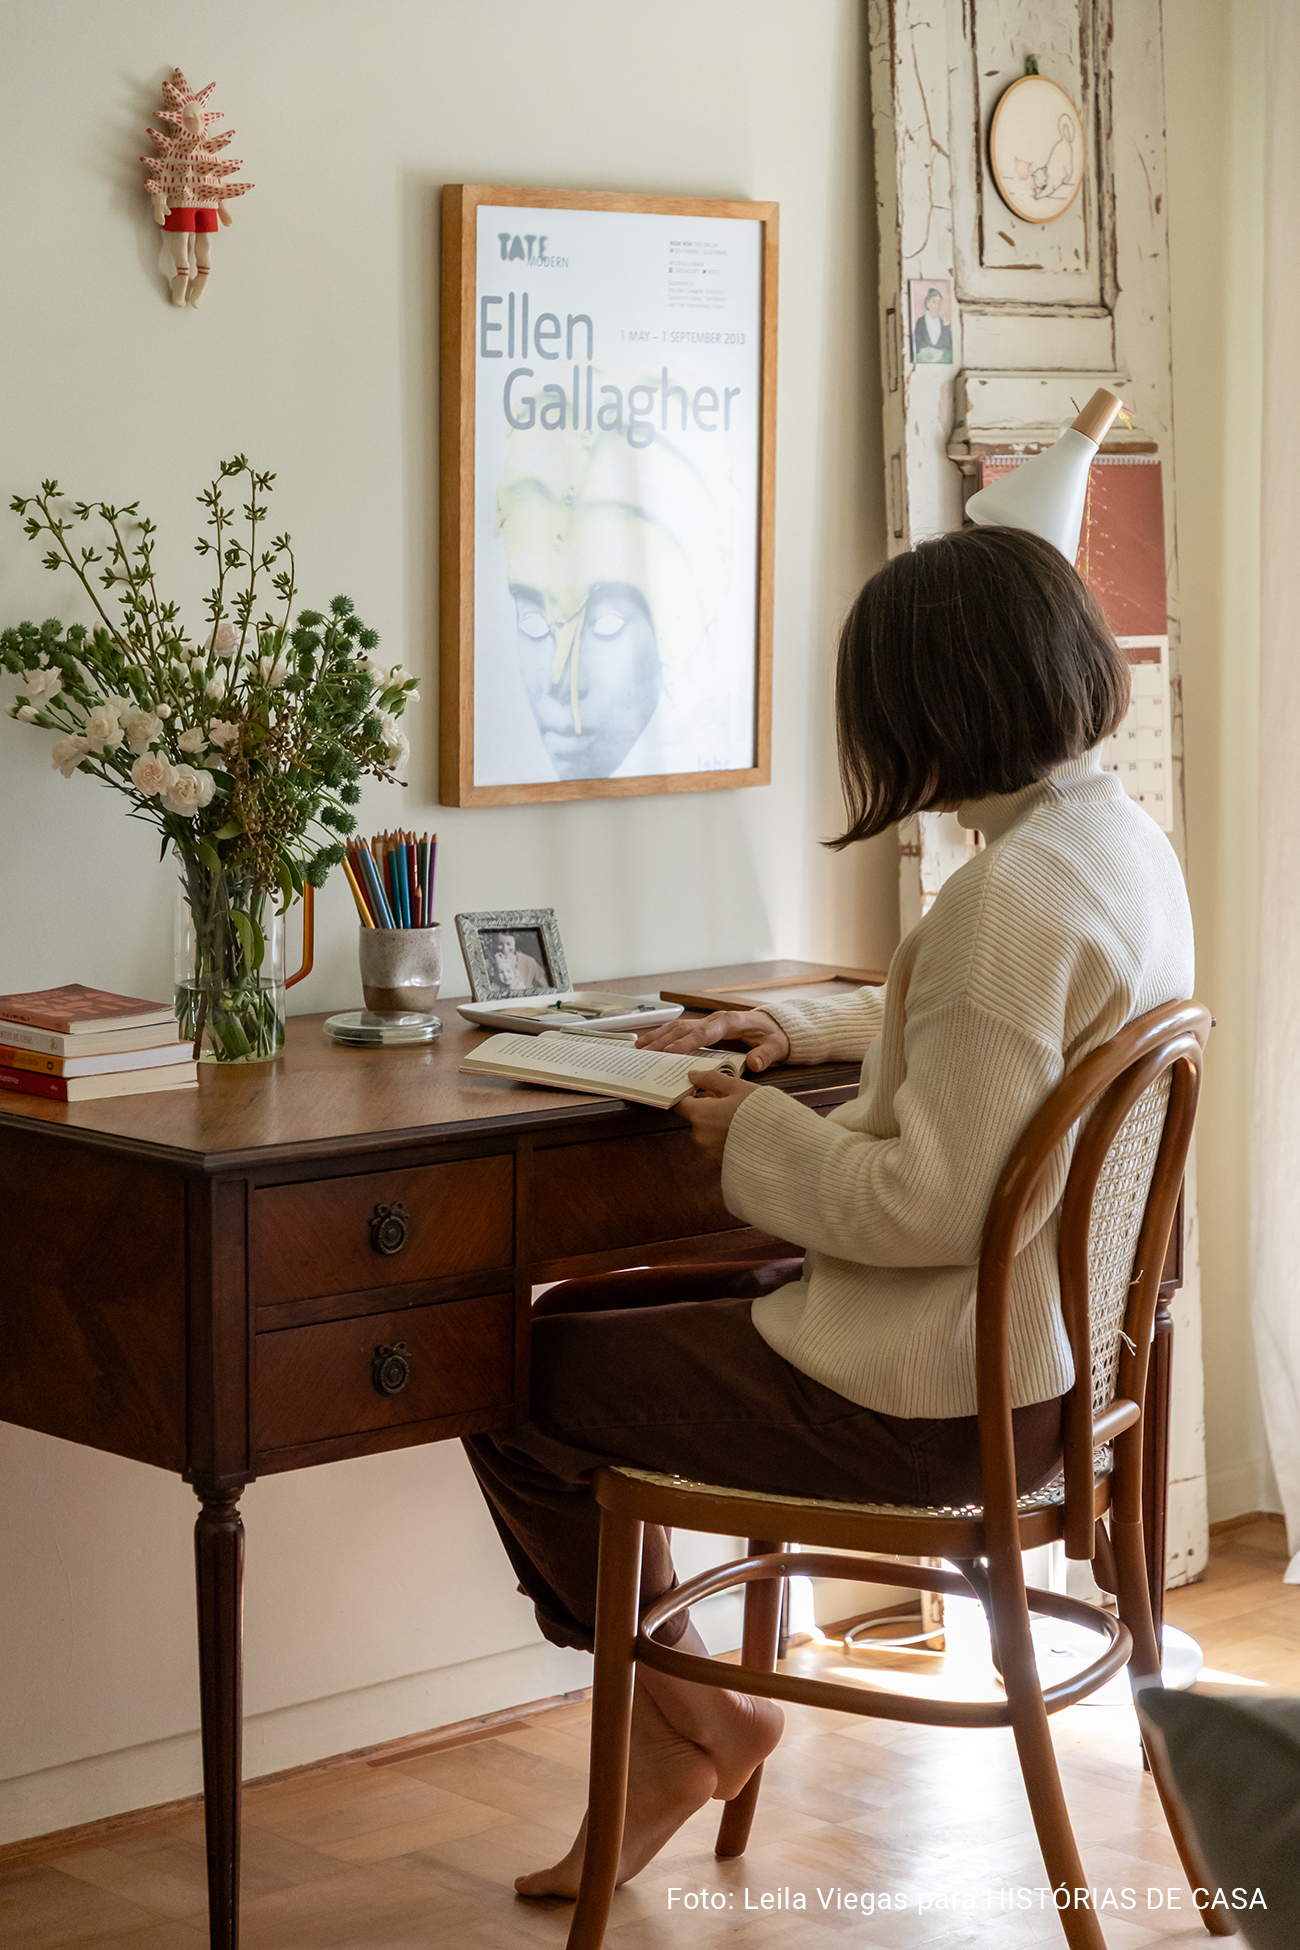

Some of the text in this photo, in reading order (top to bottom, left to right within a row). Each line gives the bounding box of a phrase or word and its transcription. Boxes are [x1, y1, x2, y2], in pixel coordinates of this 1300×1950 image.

[497, 232, 549, 262] TATE
[526, 255, 570, 268] MODERN
[480, 291, 594, 361] Ellen
[620, 329, 625, 342] 1
[628, 330, 651, 342] MAY
[662, 330, 667, 343] 1
[669, 331, 722, 344] SEPTEMBER
[724, 332, 747, 345] 2013
[503, 364, 741, 449] Gallagher
